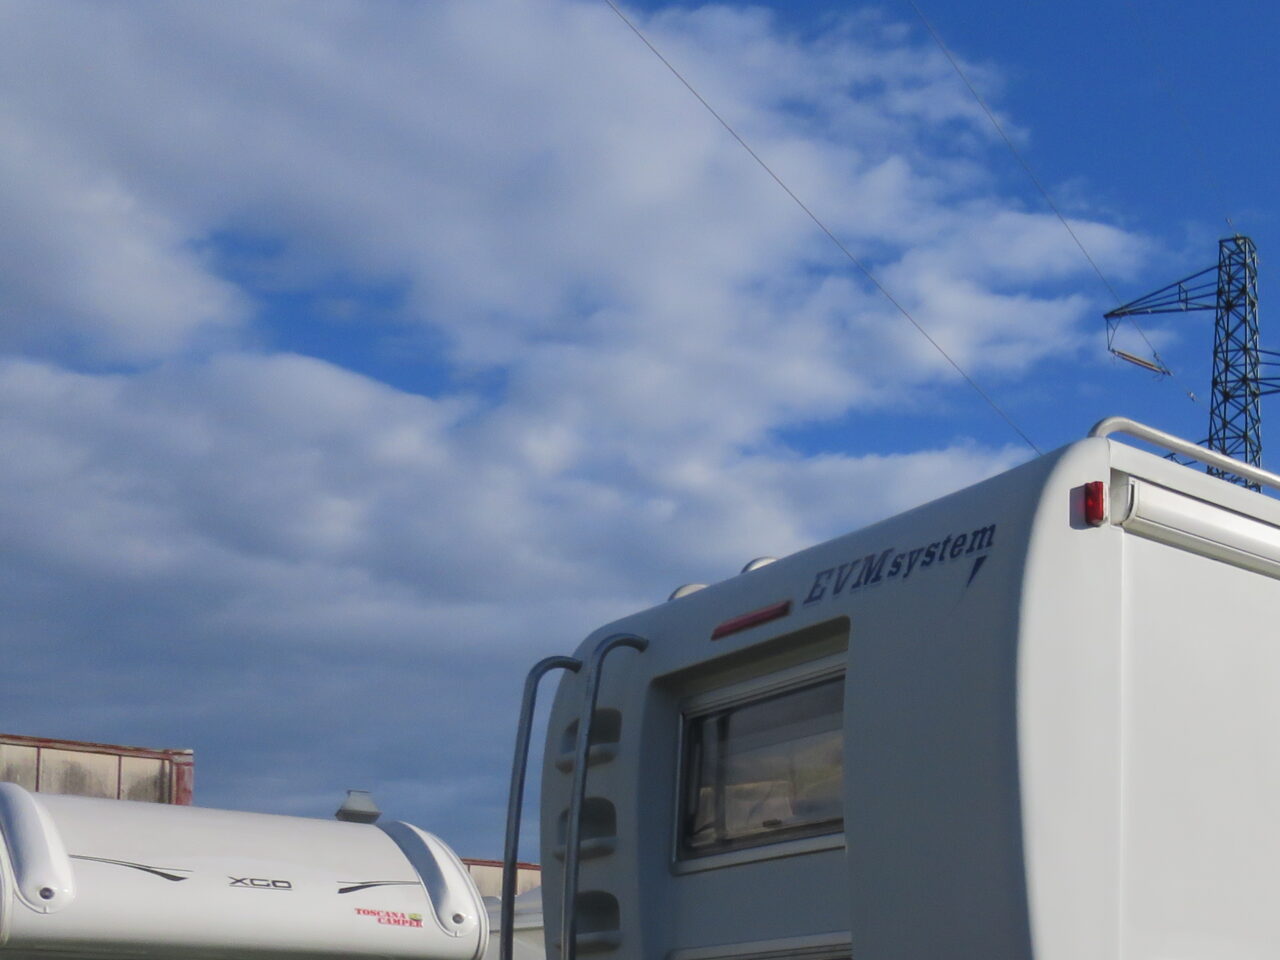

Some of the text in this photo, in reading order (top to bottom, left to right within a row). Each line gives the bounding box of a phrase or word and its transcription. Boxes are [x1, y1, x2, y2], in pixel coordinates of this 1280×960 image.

[803, 523, 997, 605] EVMsystem
[228, 876, 292, 889] XGO
[354, 907, 406, 919] TOSCANA
[377, 917, 423, 928] CAMPER
